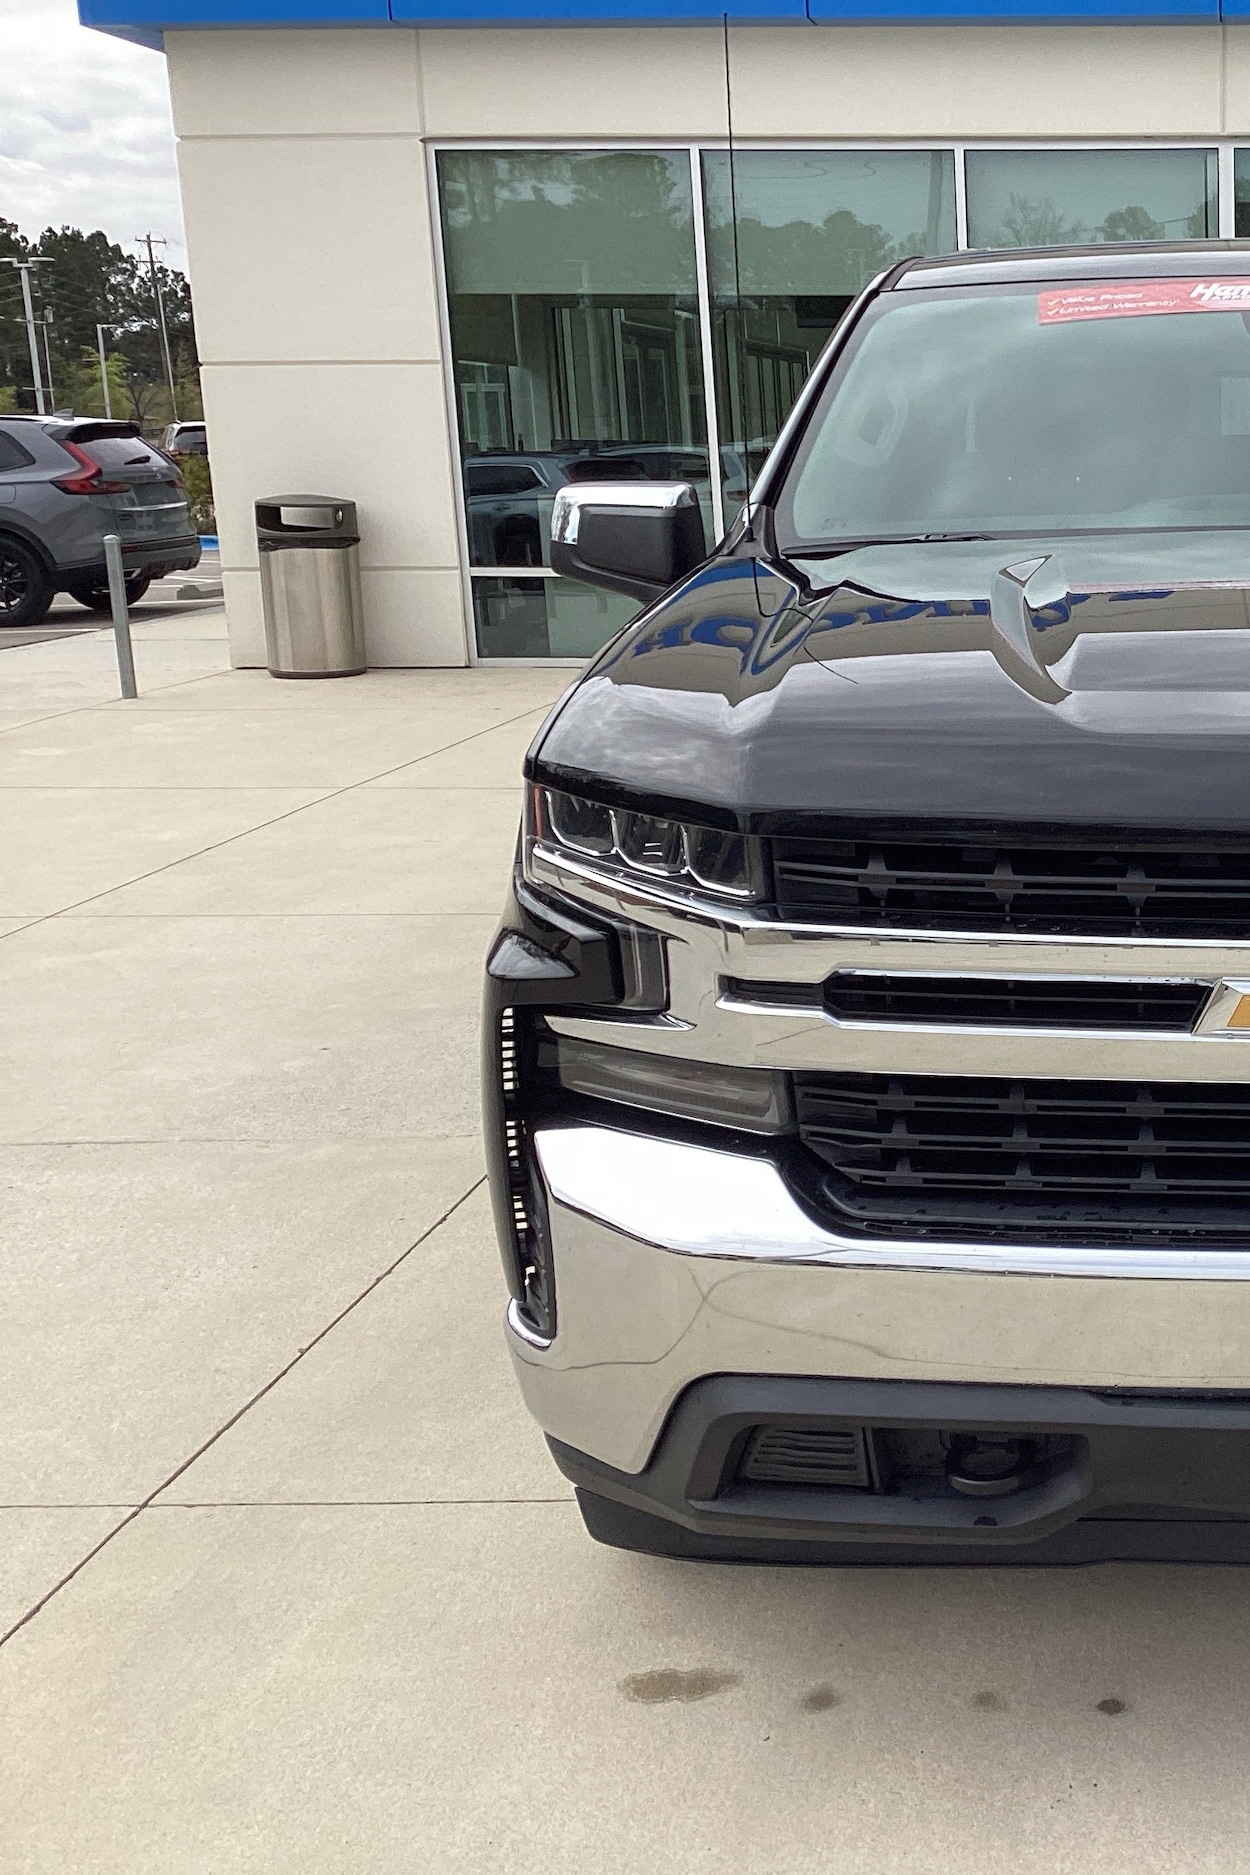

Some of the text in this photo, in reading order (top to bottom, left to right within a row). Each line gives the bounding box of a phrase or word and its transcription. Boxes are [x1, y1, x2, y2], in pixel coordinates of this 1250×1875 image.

[1060, 292, 1144, 305] Value Priced
[1059, 304, 1109, 314] Limited
